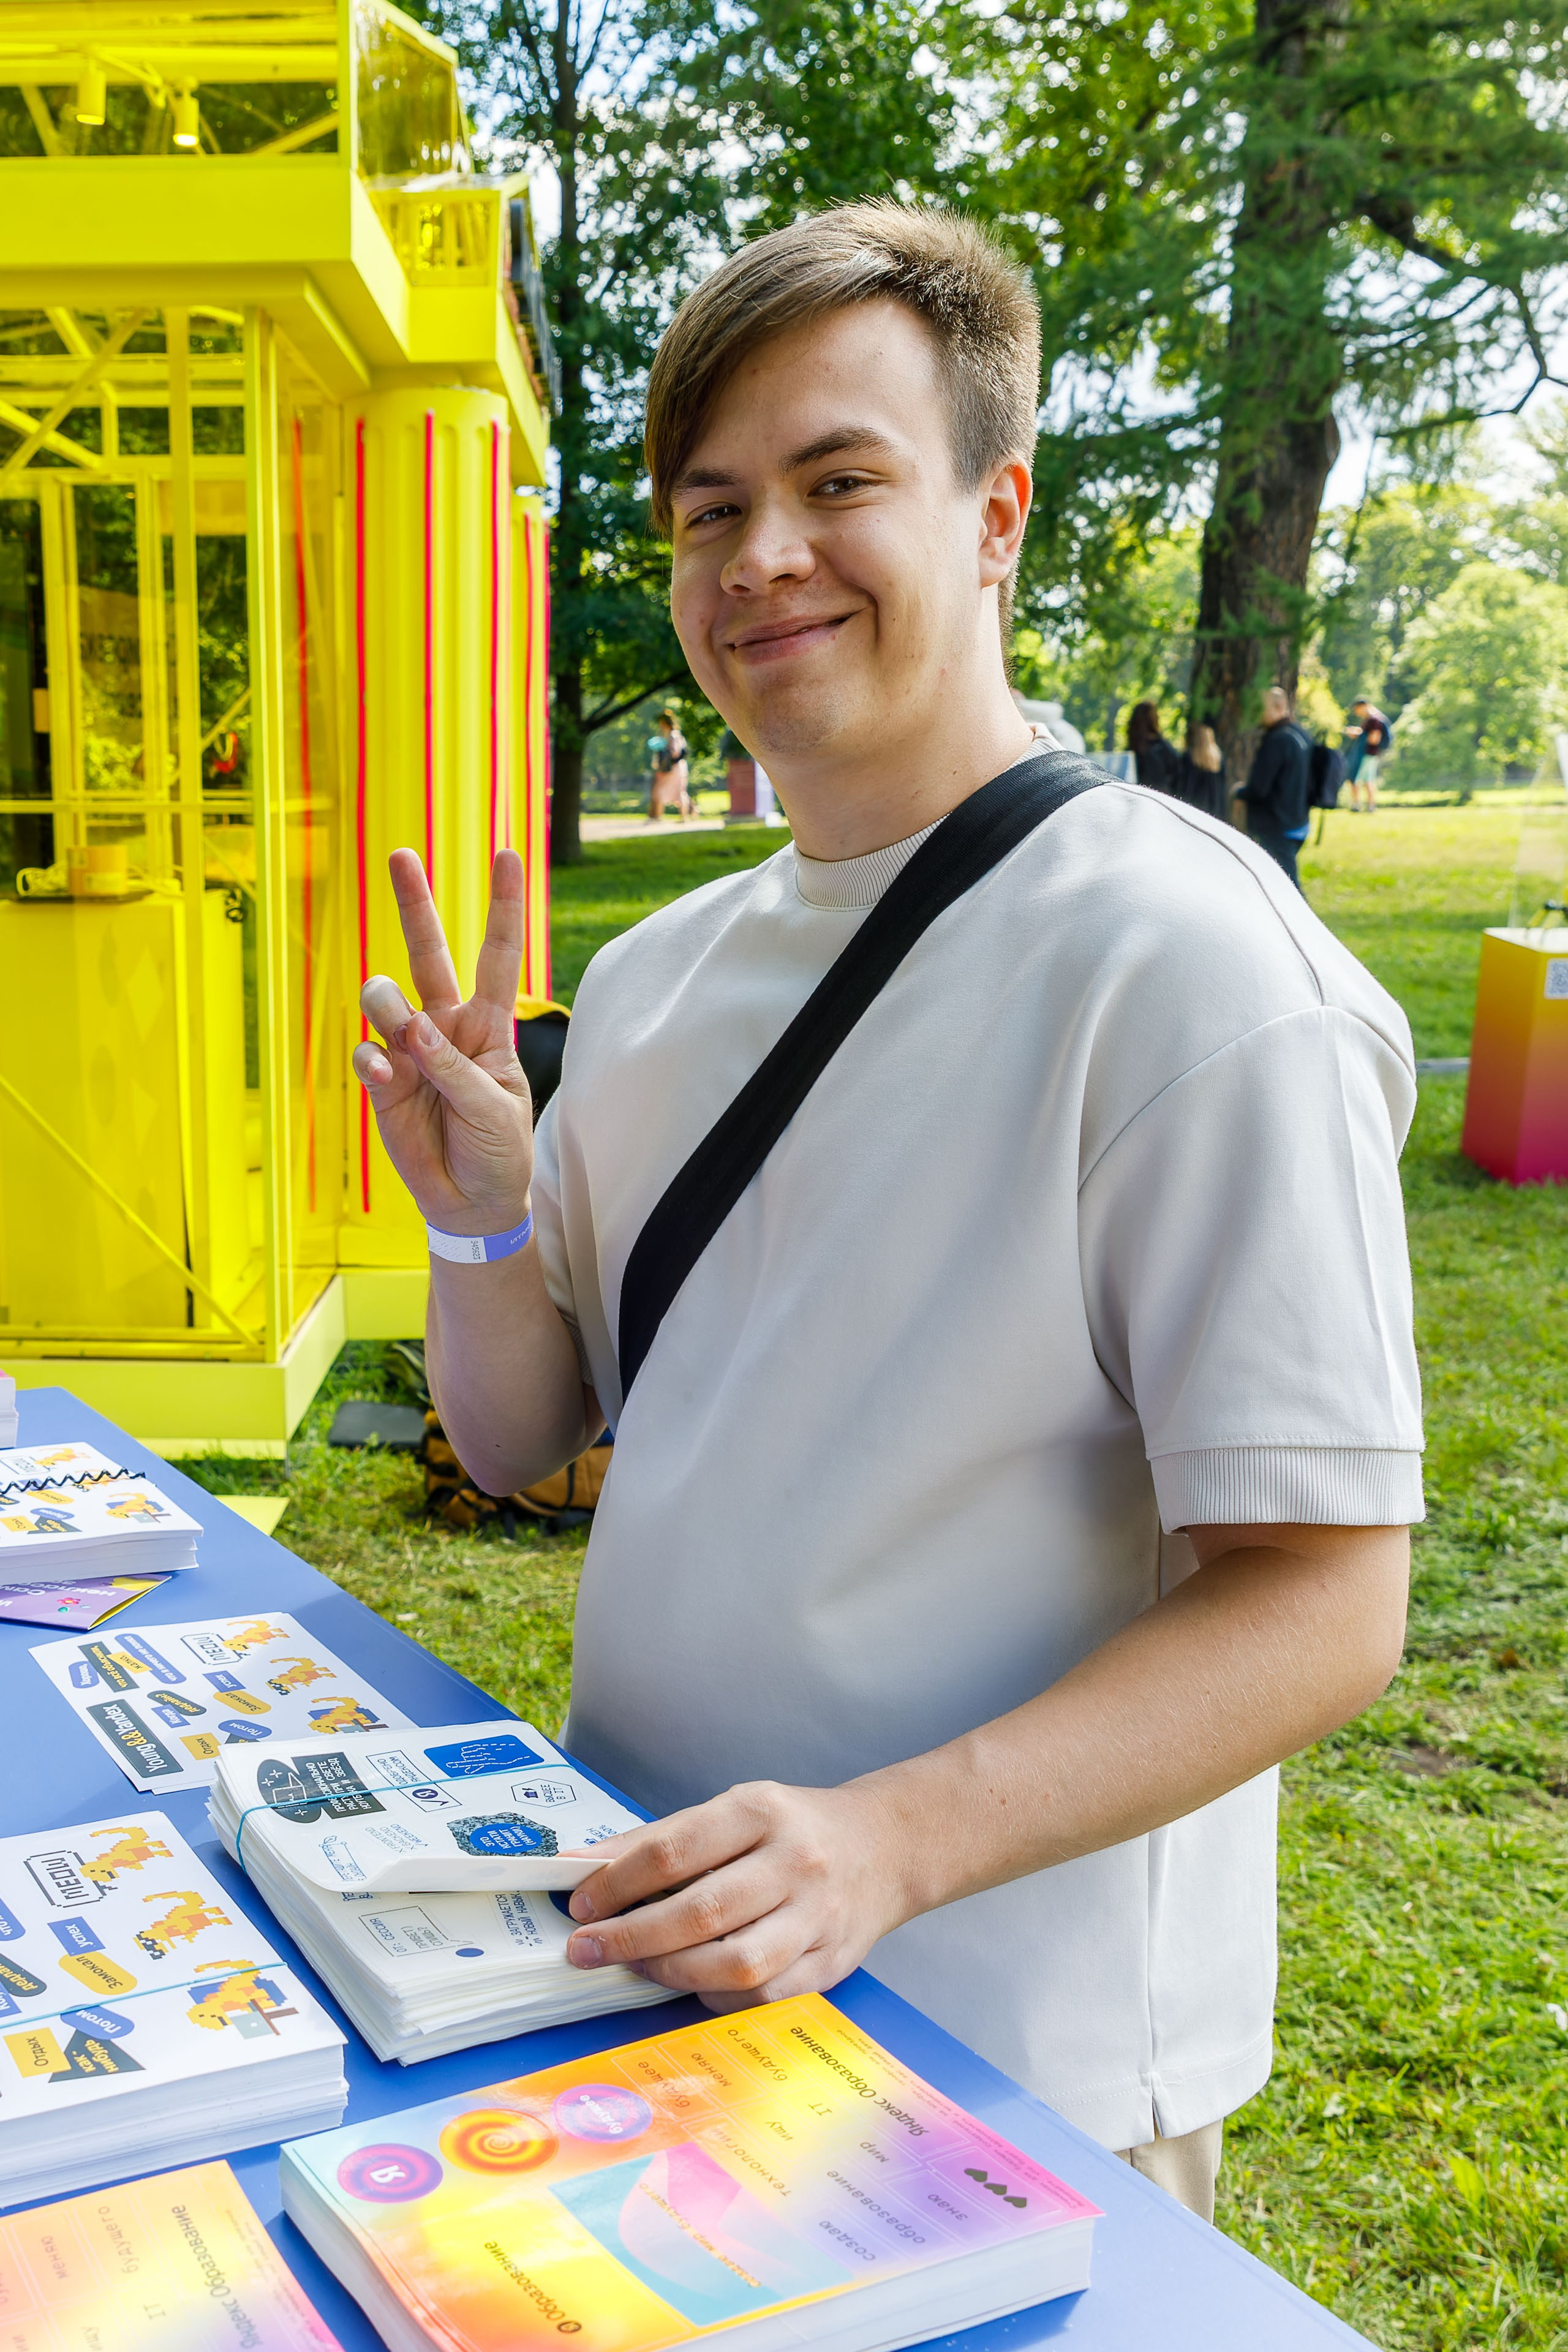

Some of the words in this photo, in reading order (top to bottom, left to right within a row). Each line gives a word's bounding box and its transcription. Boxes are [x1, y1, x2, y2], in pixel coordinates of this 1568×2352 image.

[192, 1636, 231, 1660] MEOW
[213, 1673, 236, 1687] успех
[155, 1692, 200, 1713] дедлайн?
[225, 1692, 261, 1711] Замокал
[159, 1708, 182, 1724] Когда
[100, 1704, 170, 1772] Young&&Yandex
[229, 1722, 263, 1736] Потом
[194, 1737, 216, 1754] Отдых
[317, 1761, 335, 1781] СВЕТЕ
[328, 1757, 345, 1777] ЗВЁЗД
[375, 1758, 410, 1785] ОДОБРЕНО
[388, 1756, 422, 1782] ЯНДЕКСОМ
[306, 1763, 346, 1812] ПРОФЕСИОНАЛЬНО
[330, 1782, 344, 1793] ПРИ
[345, 1785, 371, 1809] НОУТБКА
[365, 1826, 401, 1851] FRONTEND
[380, 1826, 411, 1846] BACKEND
[390, 1823, 421, 1843] WEEKEND
[480, 1836, 496, 1846] ЭТО
[487, 1831, 510, 1849] КСТАТИ
[498, 1829, 521, 1847] ГРАНИТ
[510, 1826, 537, 1845] (НАУКИ)
[598, 1825, 617, 1835] 00%
[41, 1856, 89, 1899] MEOW
[495, 1894, 522, 1936] ЗАГРУЖАЕТСЯ
[517, 1917, 538, 1935] НОВЫЙ
[65, 1923, 93, 1948] успех
[369, 1918, 394, 1940] СЕССИЯ
[401, 1926, 429, 1949] ПРИВЕТ)
[417, 1926, 443, 1946] СПИШЬ?
[393, 1943, 407, 1953] ОТ:
[76, 1955, 123, 1989] Замокал
[75, 2008, 121, 2034] Потом
[25, 2036, 49, 2067] Отдых
[71, 2049, 96, 2073] как-
[84, 2039, 119, 2073] нибудь
[723, 2028, 790, 2081] будущего
[791, 2027, 876, 2097] Образование
[687, 2052, 733, 2086] меняю
[633, 2061, 693, 2108] будущее
[872, 2097, 932, 2136] Яндекс
[761, 2119, 794, 2141] ищу
[707, 2128, 794, 2196] технологии
[855, 2140, 891, 2162] мир
[368, 2165, 408, 2184] Я
[821, 2170, 929, 2245] образование
[924, 2193, 970, 2221] знаю
[97, 2206, 140, 2274] будущего
[172, 2204, 230, 2298] Образование
[815, 2220, 878, 2261] создаю
[40, 2236, 68, 2279] меняю
[480, 2241, 568, 2320] Образование
[221, 2298, 263, 2350] Яндекс
